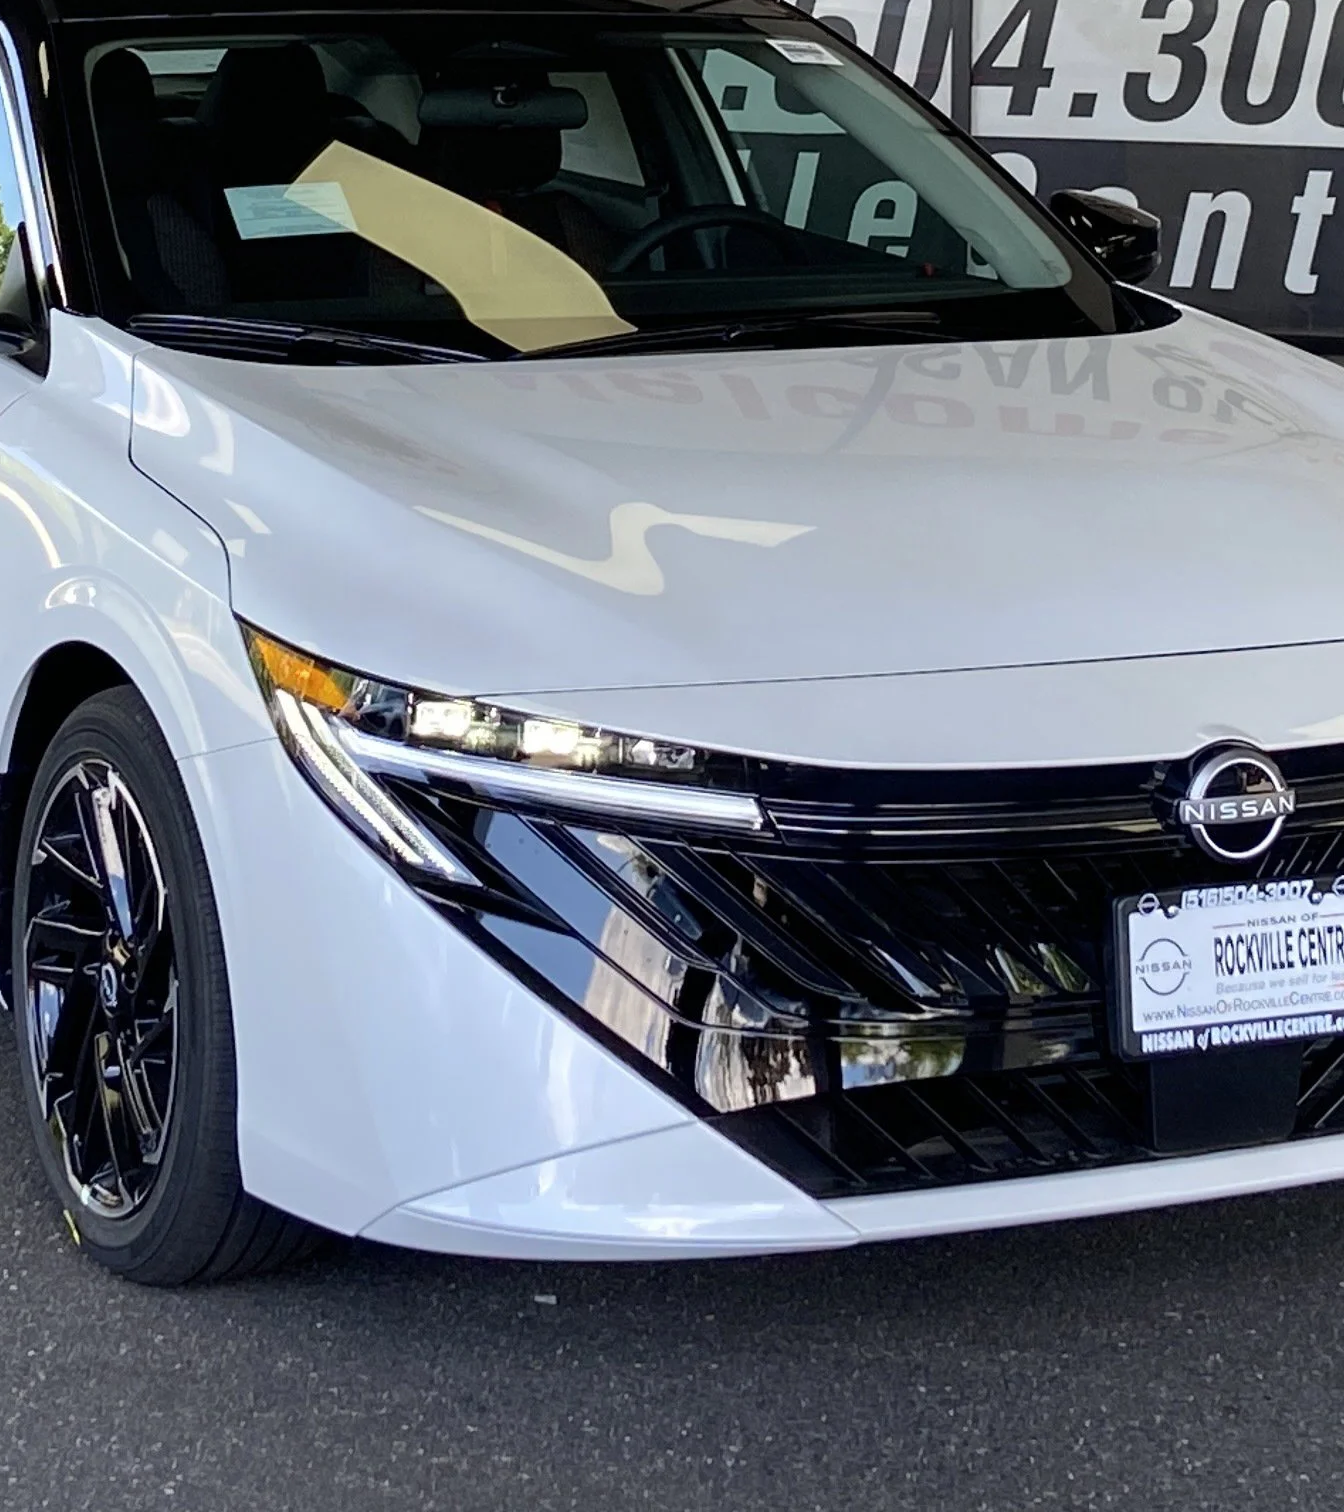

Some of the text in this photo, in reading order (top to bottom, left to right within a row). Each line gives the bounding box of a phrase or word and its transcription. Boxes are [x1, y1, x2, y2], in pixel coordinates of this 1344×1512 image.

[1184, 794, 1295, 822] NISSAN
[1247, 912, 1319, 928] NISSAN OF
[1213, 930, 1295, 977] ROCKVILLE
[1135, 959, 1193, 974] NISSAN
[1141, 1029, 1195, 1054] NISSAN
